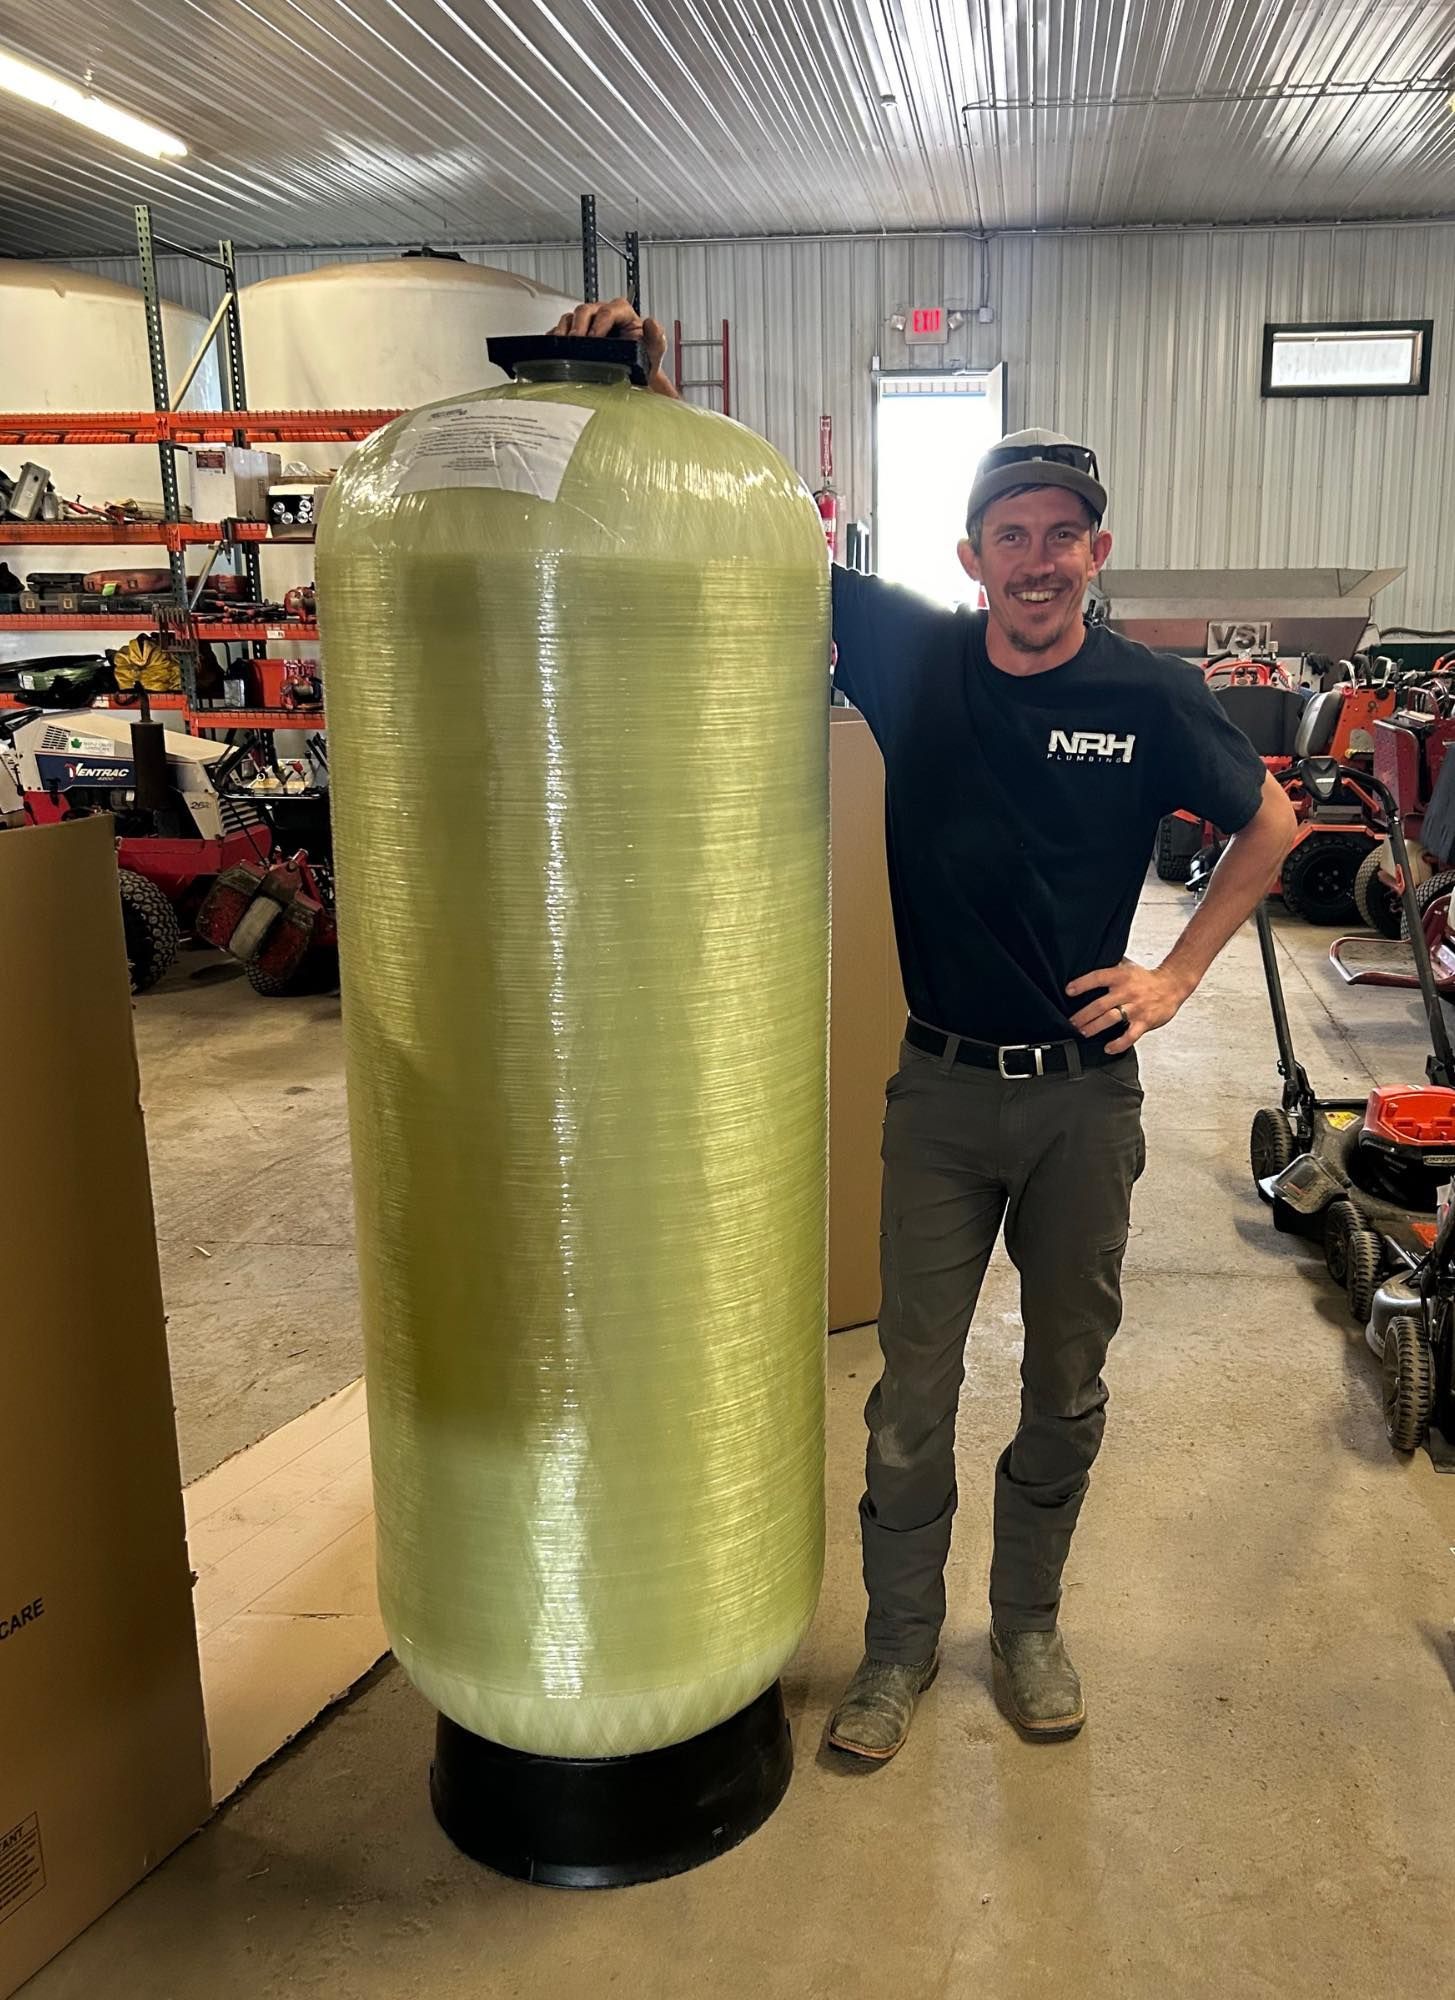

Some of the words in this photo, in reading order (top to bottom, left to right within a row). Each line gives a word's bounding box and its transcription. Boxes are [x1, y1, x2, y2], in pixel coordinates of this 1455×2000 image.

[913, 308, 941, 332] EXIT
[1211, 624, 1267, 649] VSI
[1047, 753, 1123, 763] PLUMBING
[1048, 730, 1136, 763] NRH
[65, 762, 129, 778] VENTRAC
[0, 1597, 45, 1639] CARE
[0, 1824, 24, 1852] ANT
